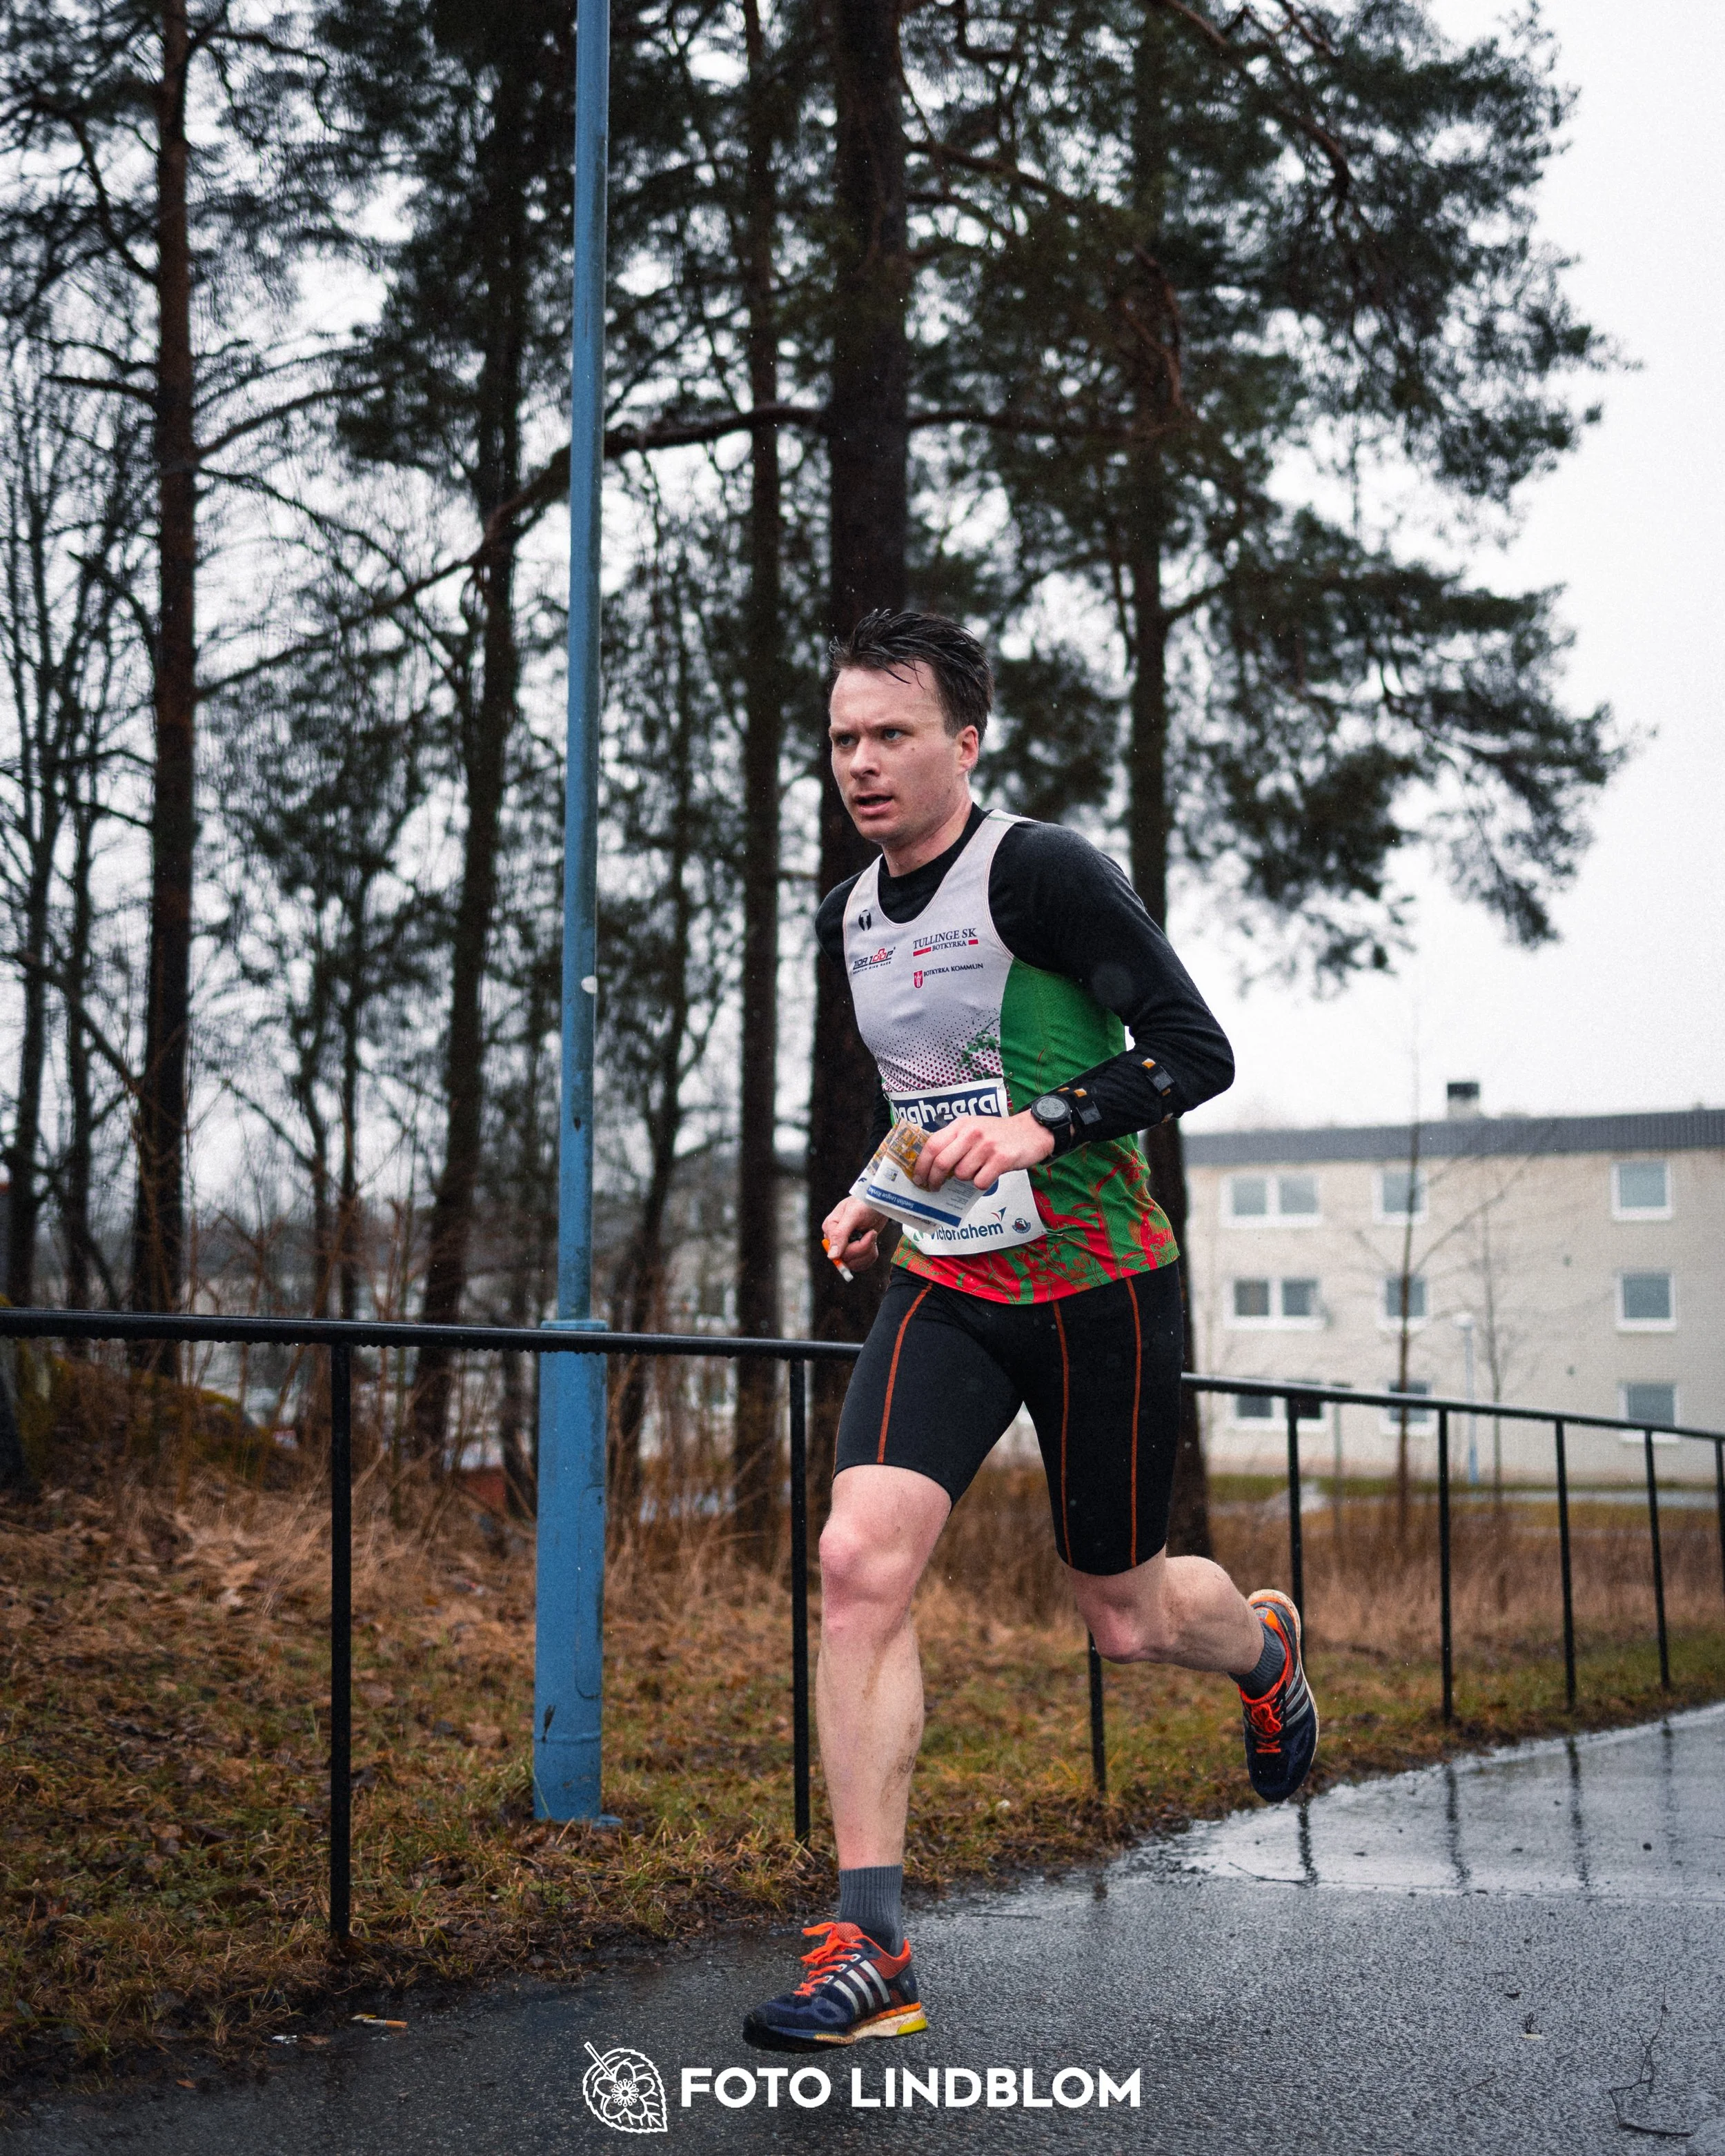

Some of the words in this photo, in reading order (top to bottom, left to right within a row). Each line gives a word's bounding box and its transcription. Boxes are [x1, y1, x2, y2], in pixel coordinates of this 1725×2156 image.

[913, 930, 960, 949] TULLINGE
[961, 928, 978, 938] SK
[931, 940, 967, 951] BOTKYRKA
[923, 967, 950, 977] BOTKYRKA
[950, 963, 984, 972] KOMMUN
